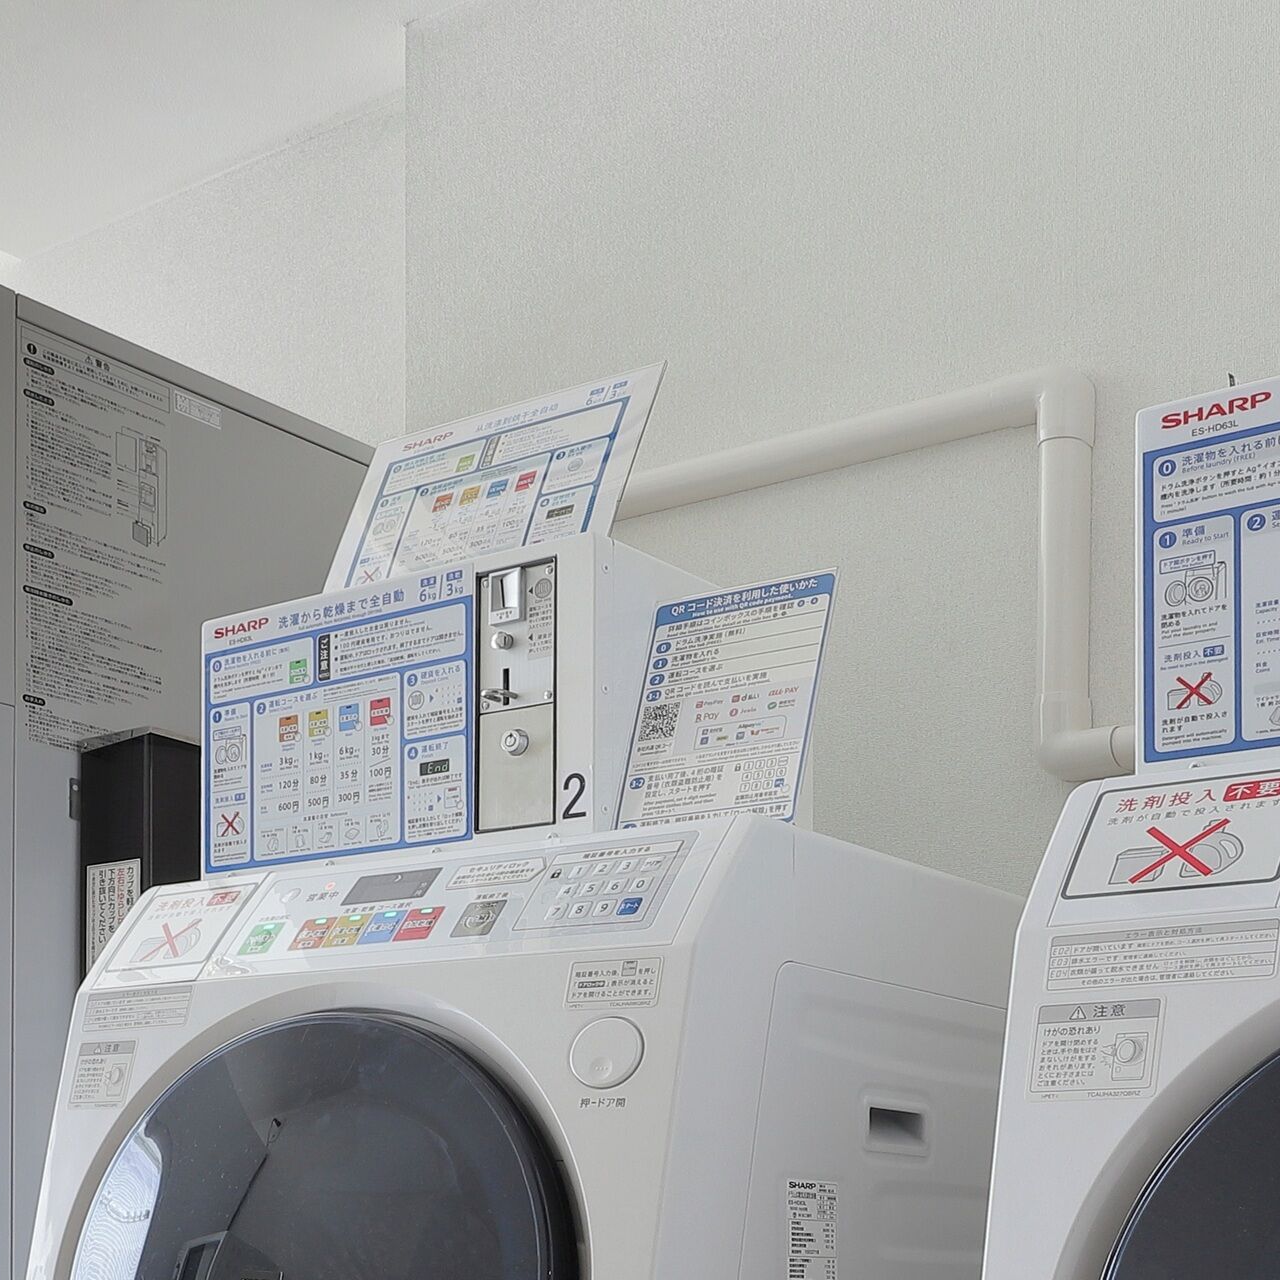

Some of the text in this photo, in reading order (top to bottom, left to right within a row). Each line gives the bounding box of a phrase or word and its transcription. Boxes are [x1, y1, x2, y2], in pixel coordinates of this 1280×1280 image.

[1161, 391, 1272, 430] SHARP
[1191, 420, 1238, 437] ES-HD63L
[402, 431, 453, 451] SHARP
[278, 589, 405, 629] 洗濯から乾燥まで全自動
[214, 617, 269, 639] SHARP
[561, 772, 587, 821] 2
[1115, 788, 1218, 814] 洗剤投入
[1093, 1004, 1126, 1018] 注意
[1044, 1025, 1100, 1036] けがの恐れあり
